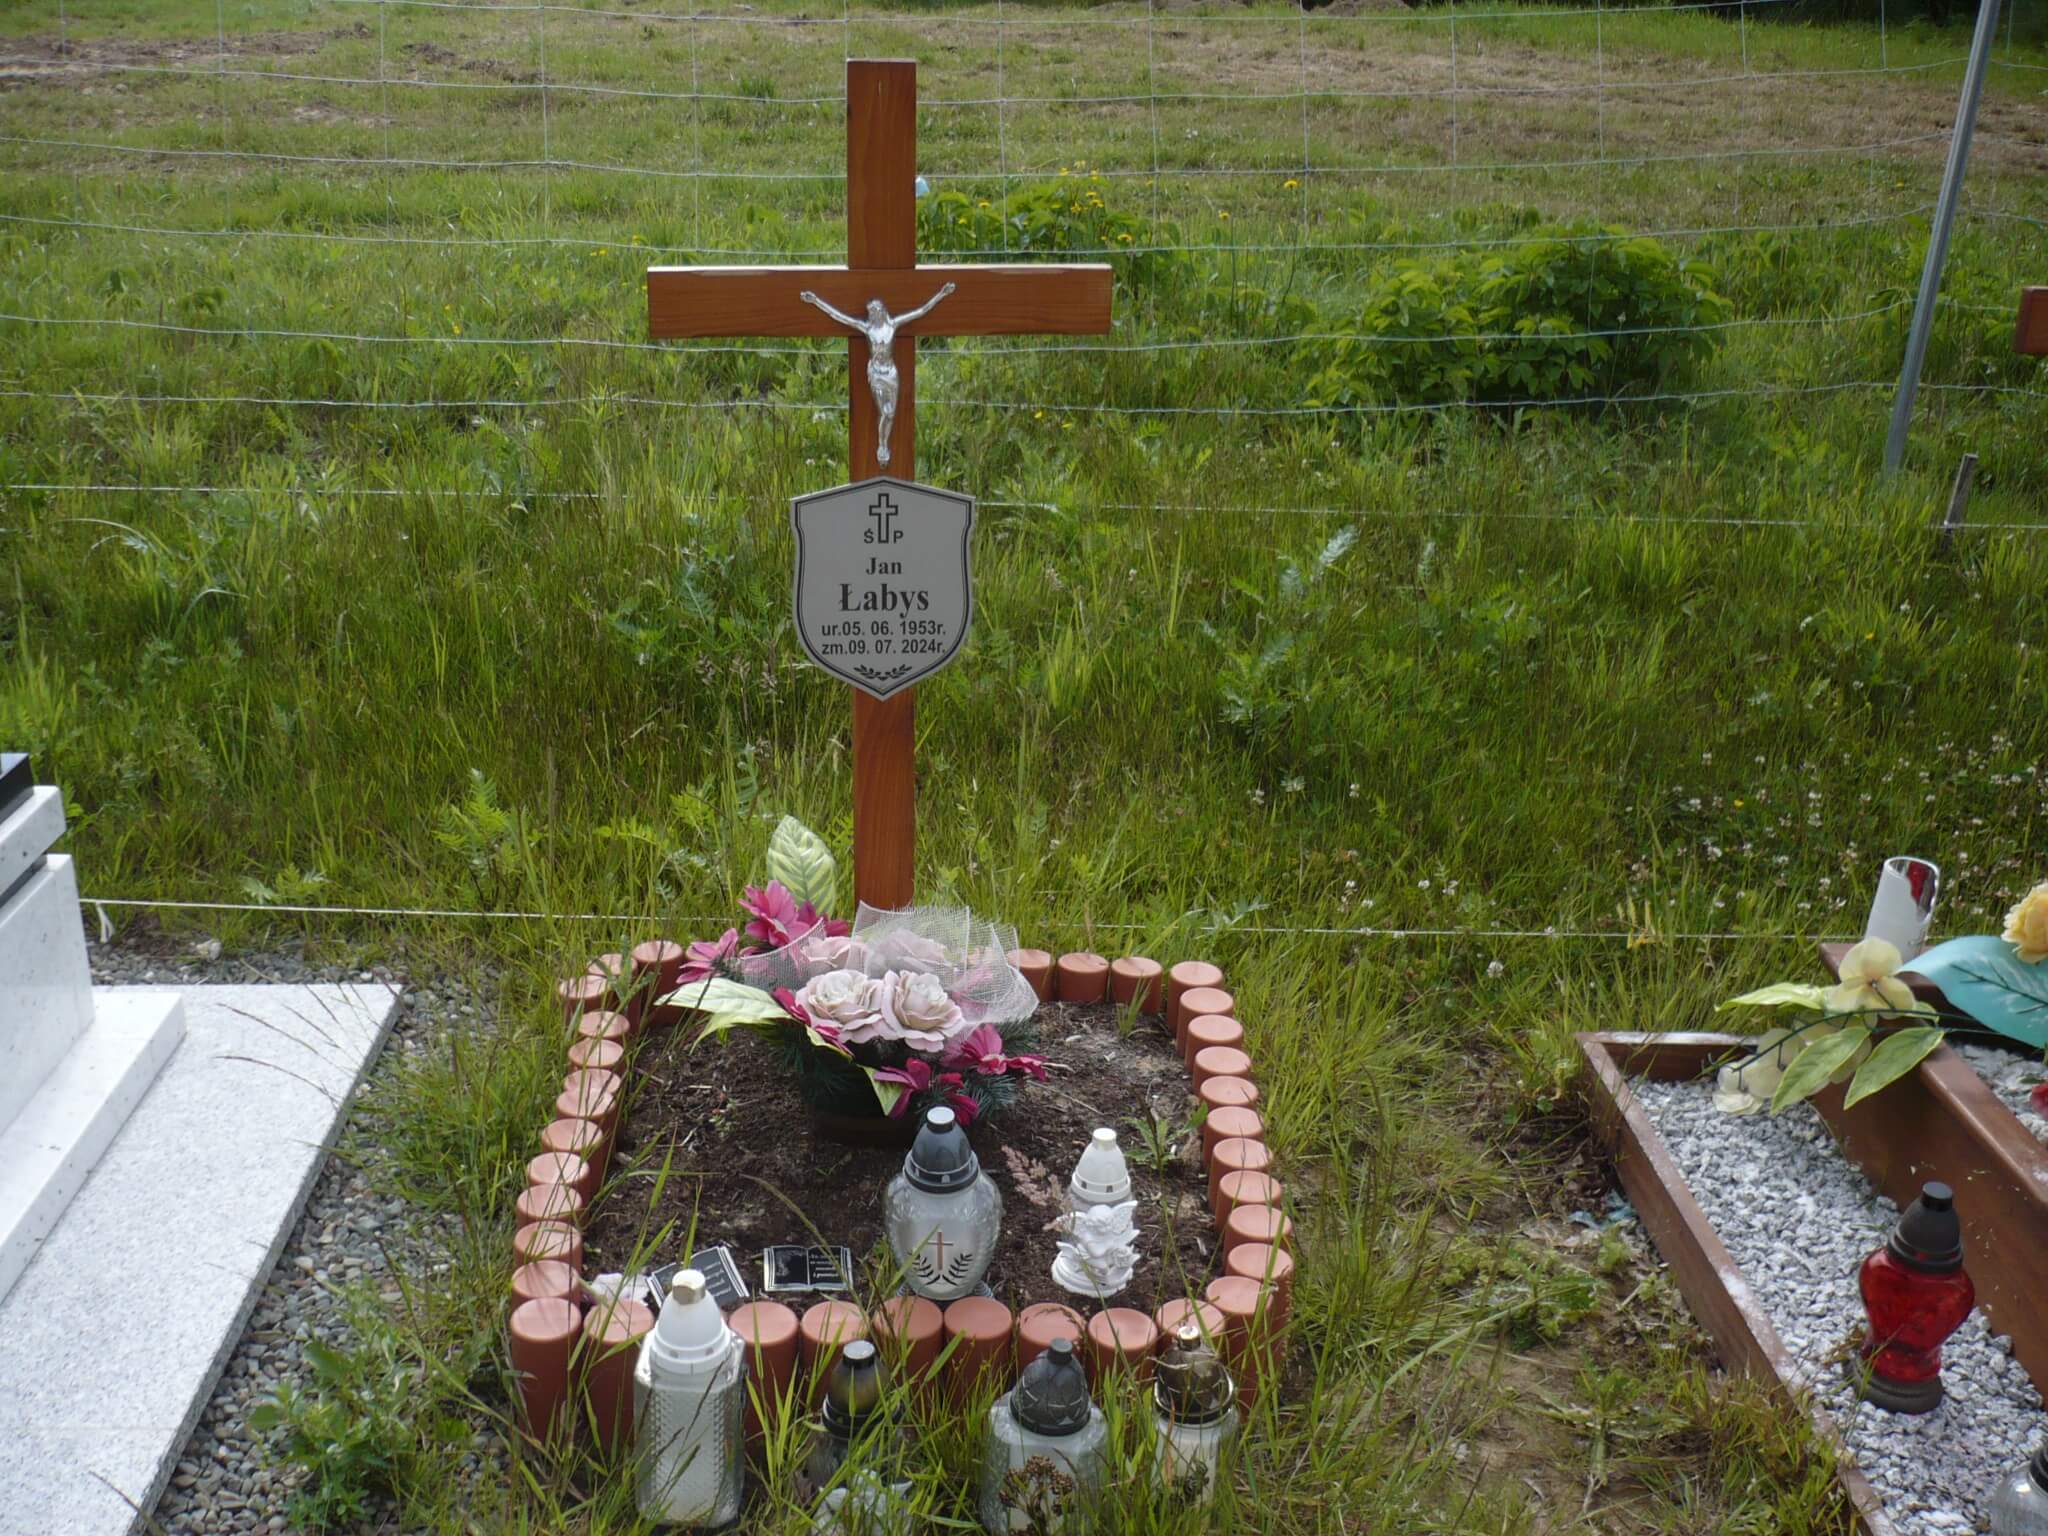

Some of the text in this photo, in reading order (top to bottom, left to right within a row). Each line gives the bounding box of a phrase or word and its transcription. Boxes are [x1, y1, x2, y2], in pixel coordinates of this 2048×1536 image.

[863, 528, 904, 544] Ś P
[866, 557, 902, 575] Jan
[839, 583, 929, 618] Łabys
[822, 620, 946, 636] ur.05. 06. 1953r.
[822, 639, 946, 655] zm.09. 07. 2024r.
